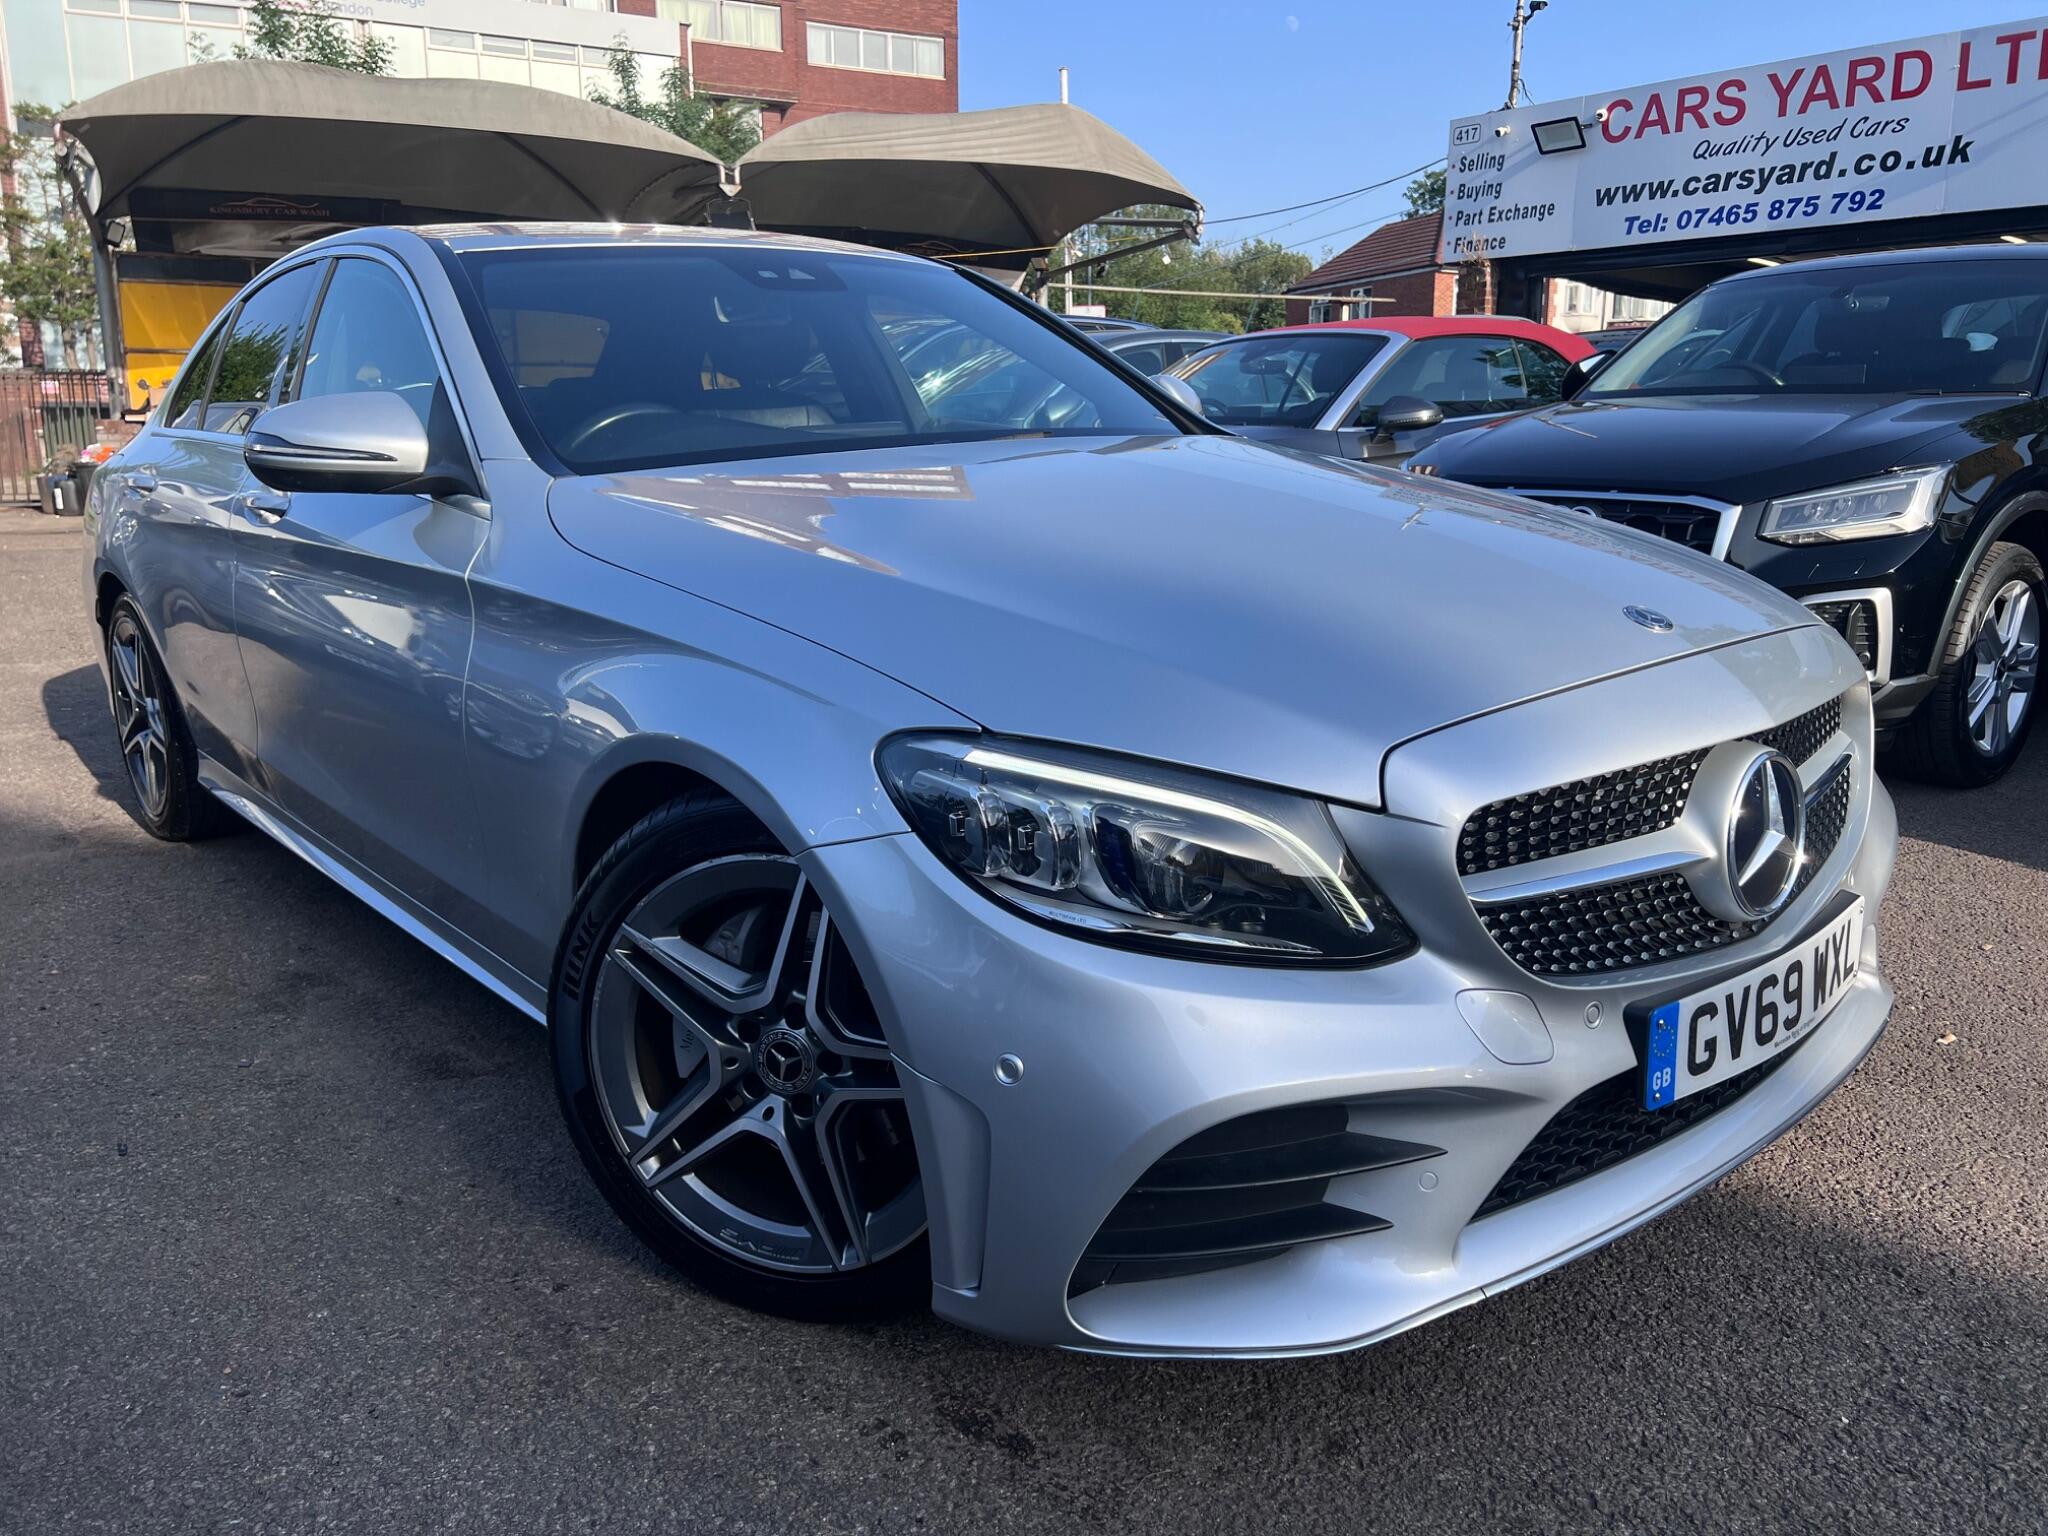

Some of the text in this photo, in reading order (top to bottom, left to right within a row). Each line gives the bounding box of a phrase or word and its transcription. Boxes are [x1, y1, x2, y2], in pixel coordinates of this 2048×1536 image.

[1601, 28, 2048, 143] CARS YARD LT
[1456, 127, 1478, 142] 417
[1692, 116, 1910, 160] Quality Used Cars
[1459, 152, 1505, 173] Selling
[1595, 134, 1975, 207] www.carsyard.co.uk
[1457, 180, 1503, 202] Buying
[275, 207, 297, 216] CAR
[1455, 202, 1555, 227] Part Exchange
[1624, 188, 1885, 235] Tel: 07465 875 792
[1453, 236, 1506, 254] Finance
[1687, 917, 1855, 1077] GV69 WXL
[1652, 1067, 1671, 1091] GB
